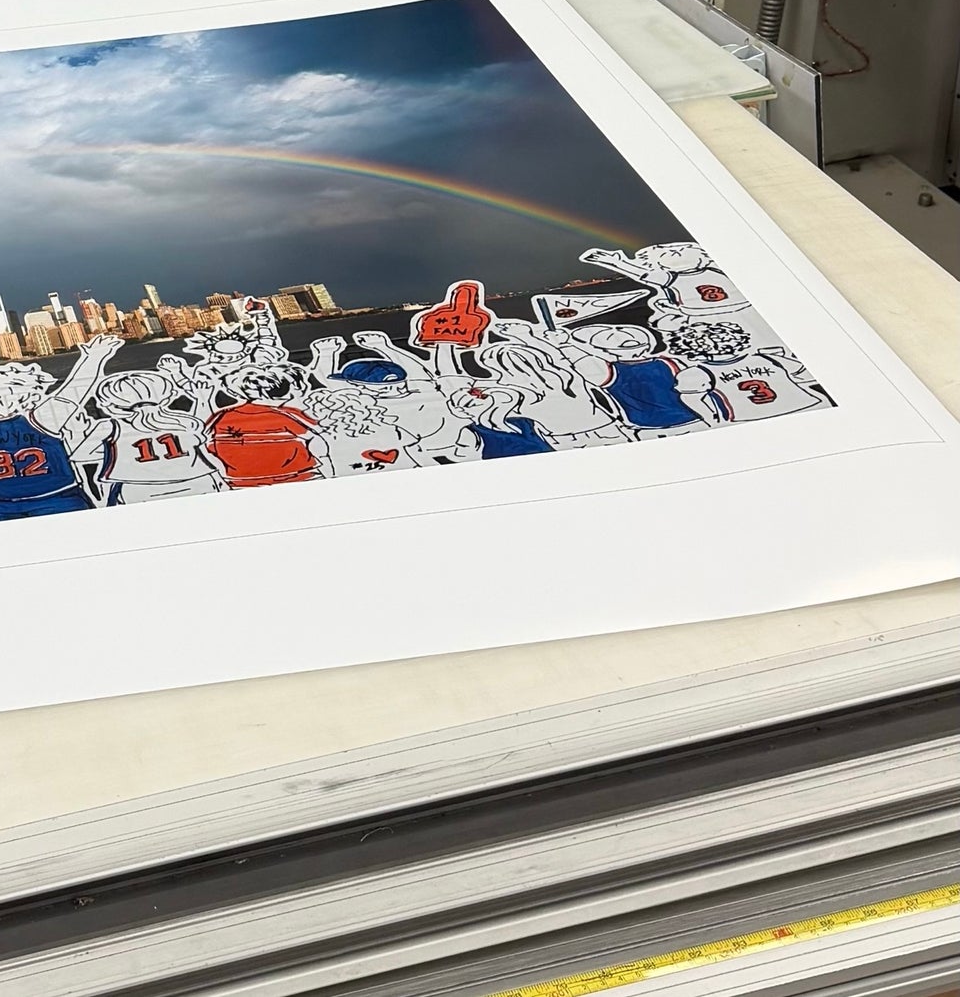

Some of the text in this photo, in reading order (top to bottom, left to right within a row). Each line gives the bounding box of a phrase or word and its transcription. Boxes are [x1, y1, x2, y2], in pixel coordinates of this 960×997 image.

[554, 299, 609, 308] NYC
[435, 315, 461, 325] #1
[433, 328, 467, 336] FAN
[719, 366, 776, 383] NEW YORK
[737, 379, 778, 405] 3
[131, 433, 190, 463] 11
